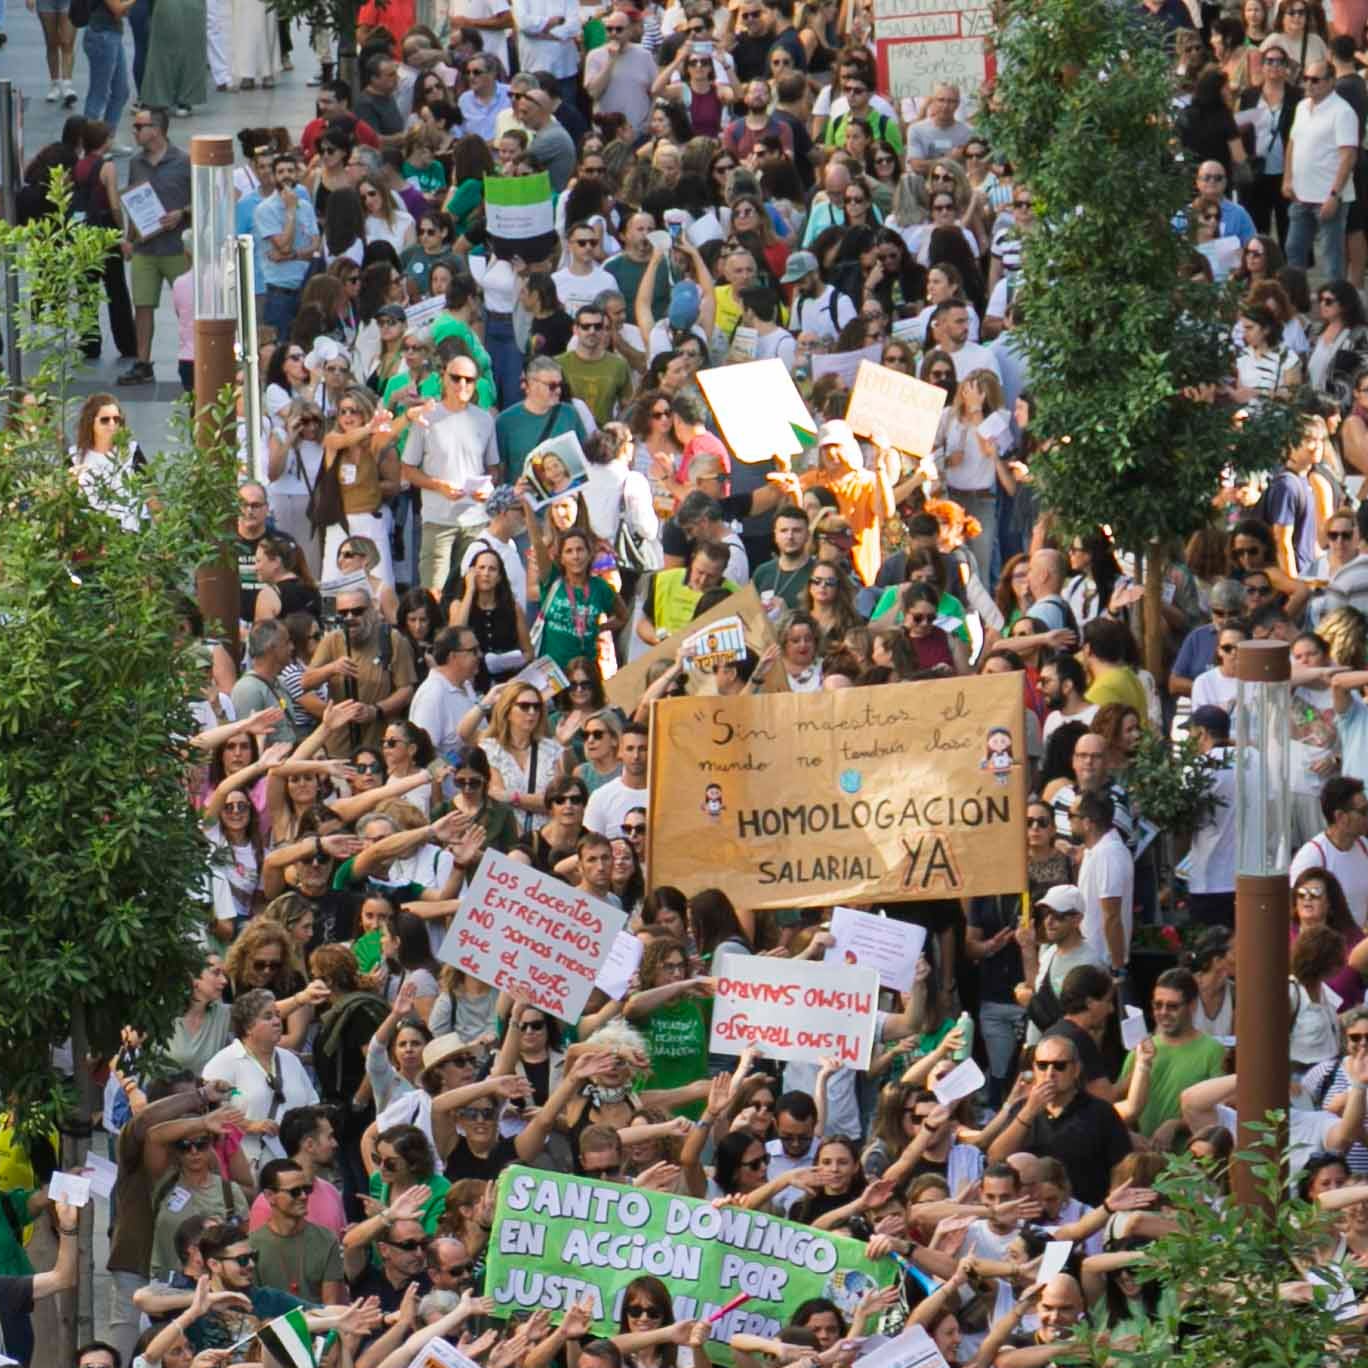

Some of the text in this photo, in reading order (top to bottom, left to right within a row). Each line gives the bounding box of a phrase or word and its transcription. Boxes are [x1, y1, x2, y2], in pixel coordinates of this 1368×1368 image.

[796, 703, 918, 732] maestros
[938, 691, 971, 721] el
[697, 757, 771, 773] mundo
[796, 755, 823, 769] no
[737, 788, 1011, 838] HOMOLOGACIÓN
[757, 855, 881, 885] SALARIAL
[900, 835, 961, 889] YA
[467, 906, 495, 930] NO
[501, 925, 554, 959] somos
[524, 879, 603, 935] docentes
[458, 928, 570, 999] que el resto
[459, 954, 481, 974] de
[507, 1175, 653, 1228] SANTO
[499, 1219, 547, 1257] EN
[720, 1253, 789, 1302] POR
[493, 1267, 605, 1323] JUSTA
